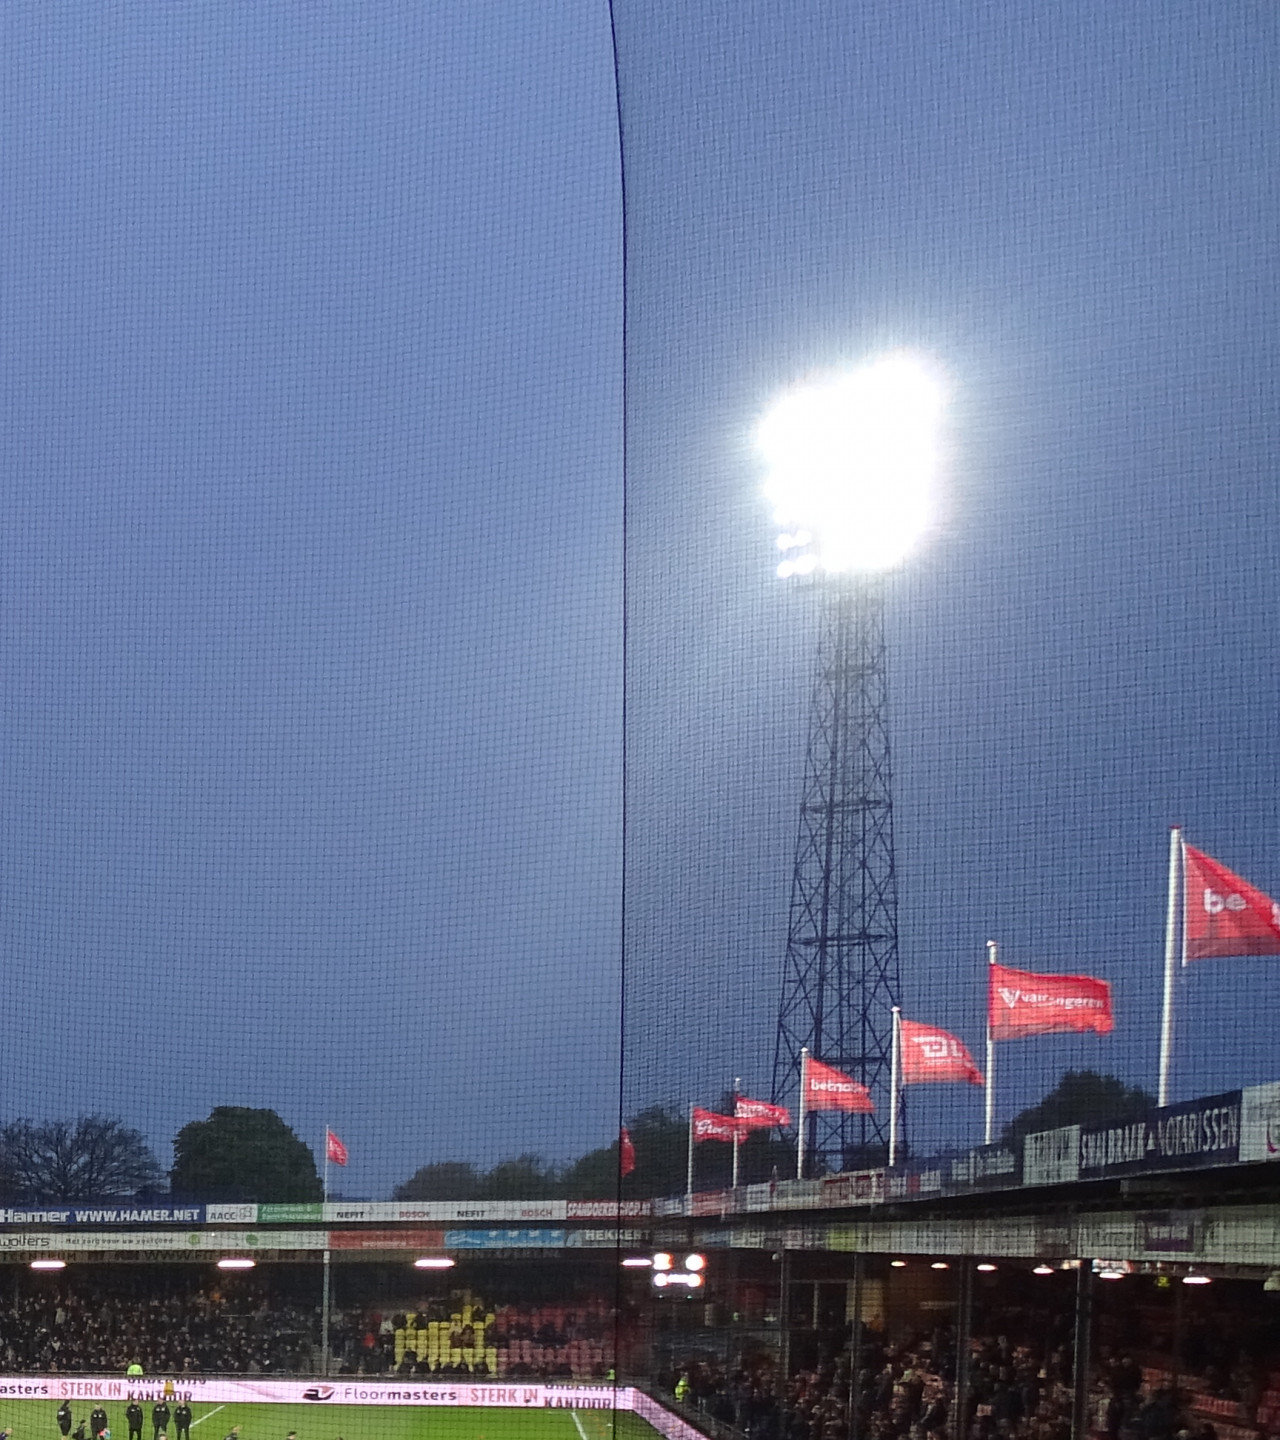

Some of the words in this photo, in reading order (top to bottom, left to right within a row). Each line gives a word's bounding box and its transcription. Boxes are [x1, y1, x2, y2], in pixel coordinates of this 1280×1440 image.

[1158, 1104, 1239, 1156] NOTARISSEN
[0, 1209, 70, 1223] Hamer
[76, 1210, 200, 1222] WWW.HAMER.NET
[336, 1211, 364, 1219] NEFIT
[457, 1210, 485, 1218] NEFIT
[521, 1209, 553, 1217] BOSCH
[61, 1382, 102, 1396] STERK
[108, 1383, 122, 1396] IN
[344, 1388, 457, 1401] Floormasters
[471, 1388, 517, 1402] STERK
[523, 1388, 538, 1403] IN
